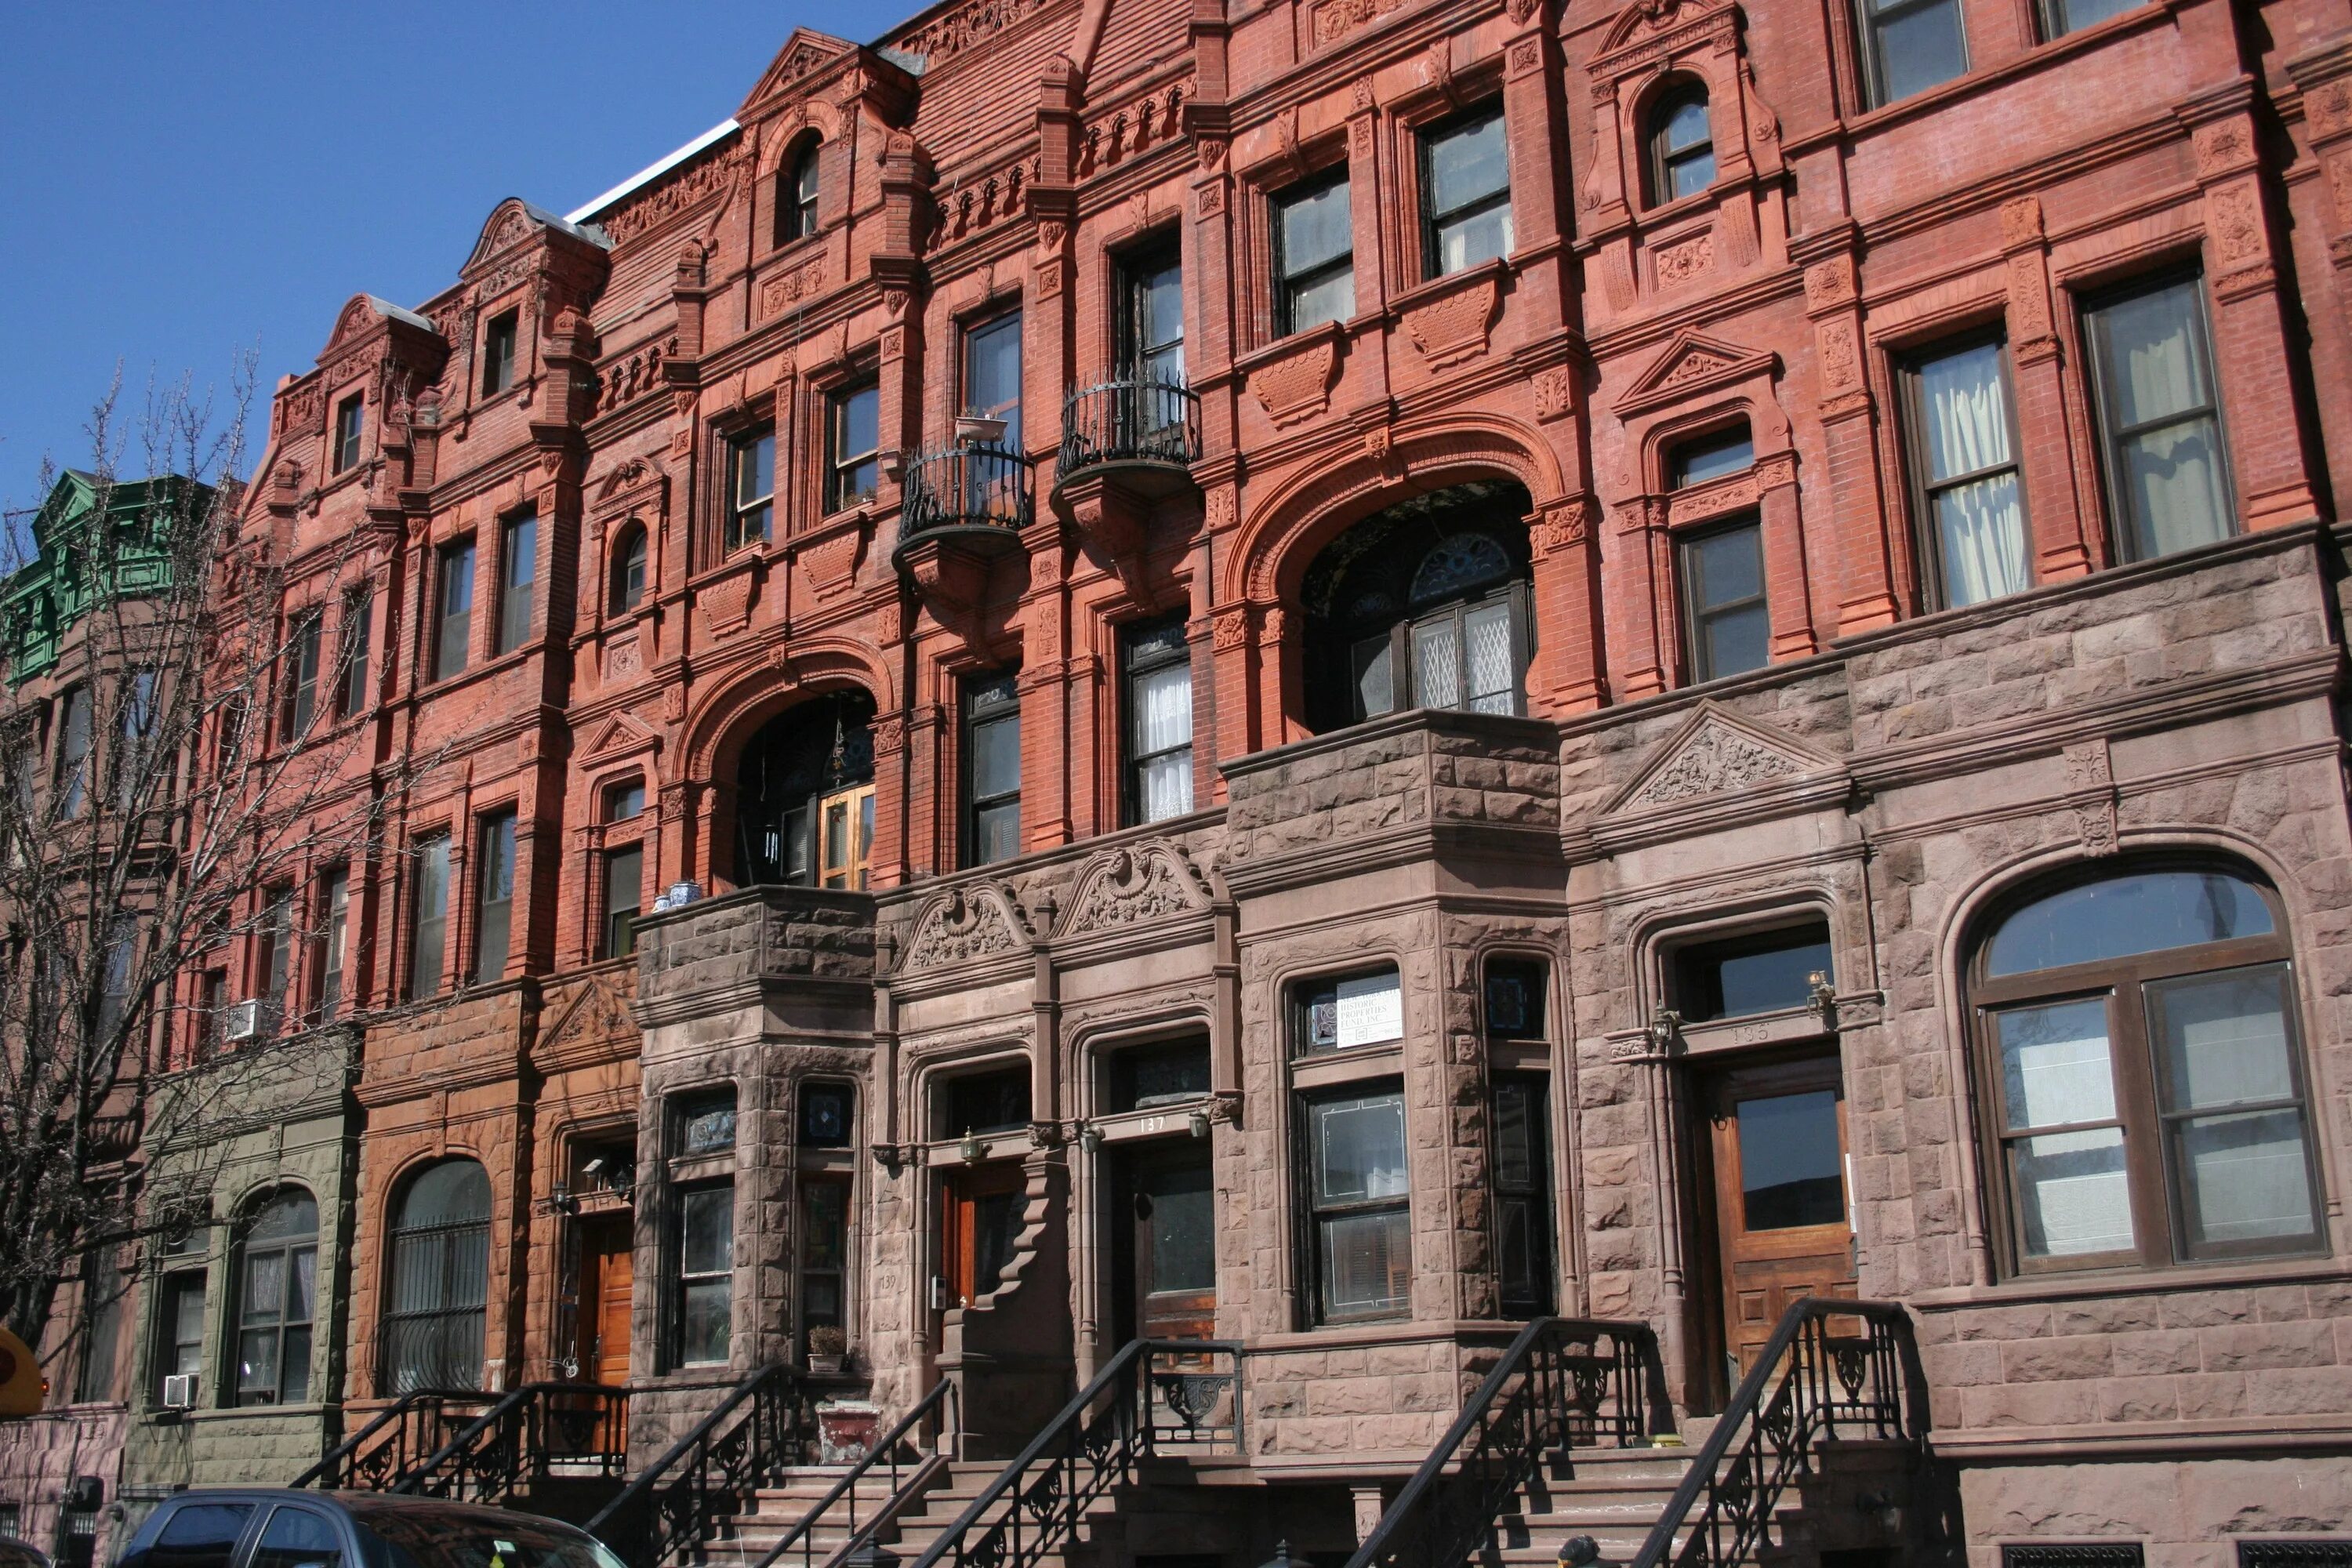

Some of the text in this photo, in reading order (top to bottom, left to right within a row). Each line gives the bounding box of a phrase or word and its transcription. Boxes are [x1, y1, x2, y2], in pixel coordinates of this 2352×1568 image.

[1341, 997, 1377, 1011] HISTORIC
[1341, 1004, 1388, 1019] PROPERTIES
[1731, 1022, 1769, 1044] 135
[1141, 1116, 1164, 1133] 137
[879, 1275, 896, 1290] 139
